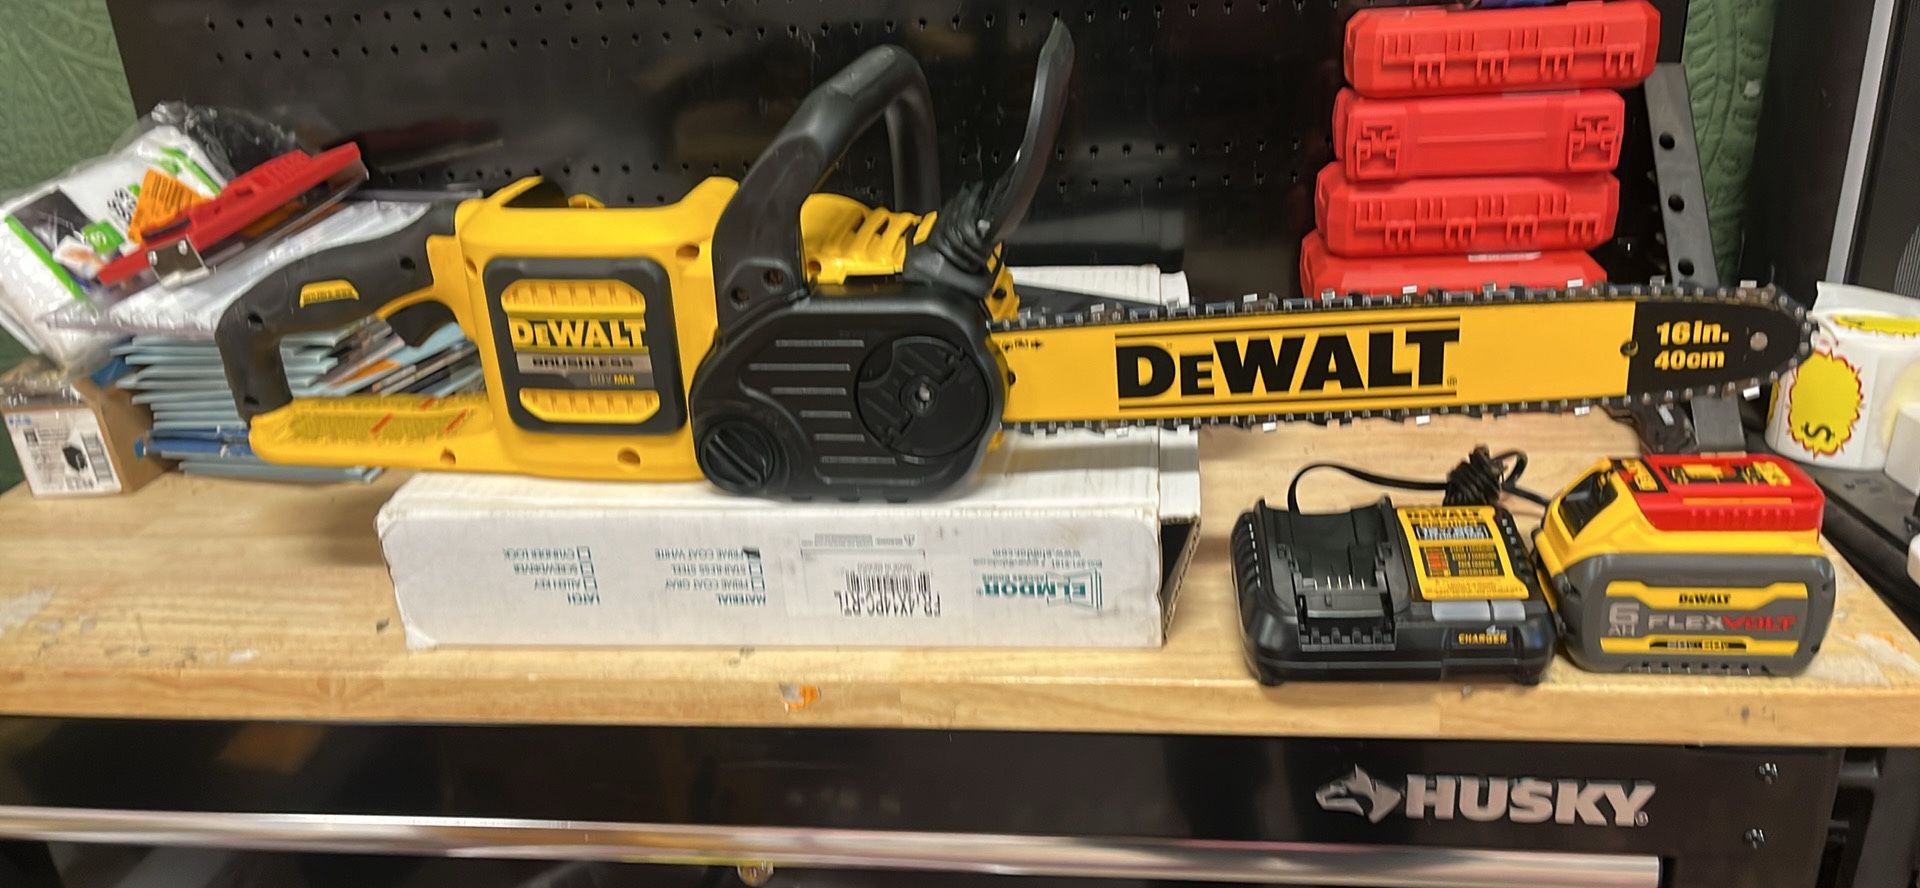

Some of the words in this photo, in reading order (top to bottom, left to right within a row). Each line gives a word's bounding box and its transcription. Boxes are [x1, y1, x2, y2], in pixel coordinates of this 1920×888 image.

[511, 319, 647, 348] DEWALT
[1656, 320, 1730, 346] 16in.
[1115, 329, 1461, 398] DEWALT
[1654, 349, 1725, 370] 40cm
[715, 593, 767, 607] MATERIAL
[983, 582, 1087, 600] ELMDOR
[1608, 602, 1641, 627] 6
[1648, 614, 1798, 631] FLEXVOLT
[1406, 773, 1656, 828] HUSKY
